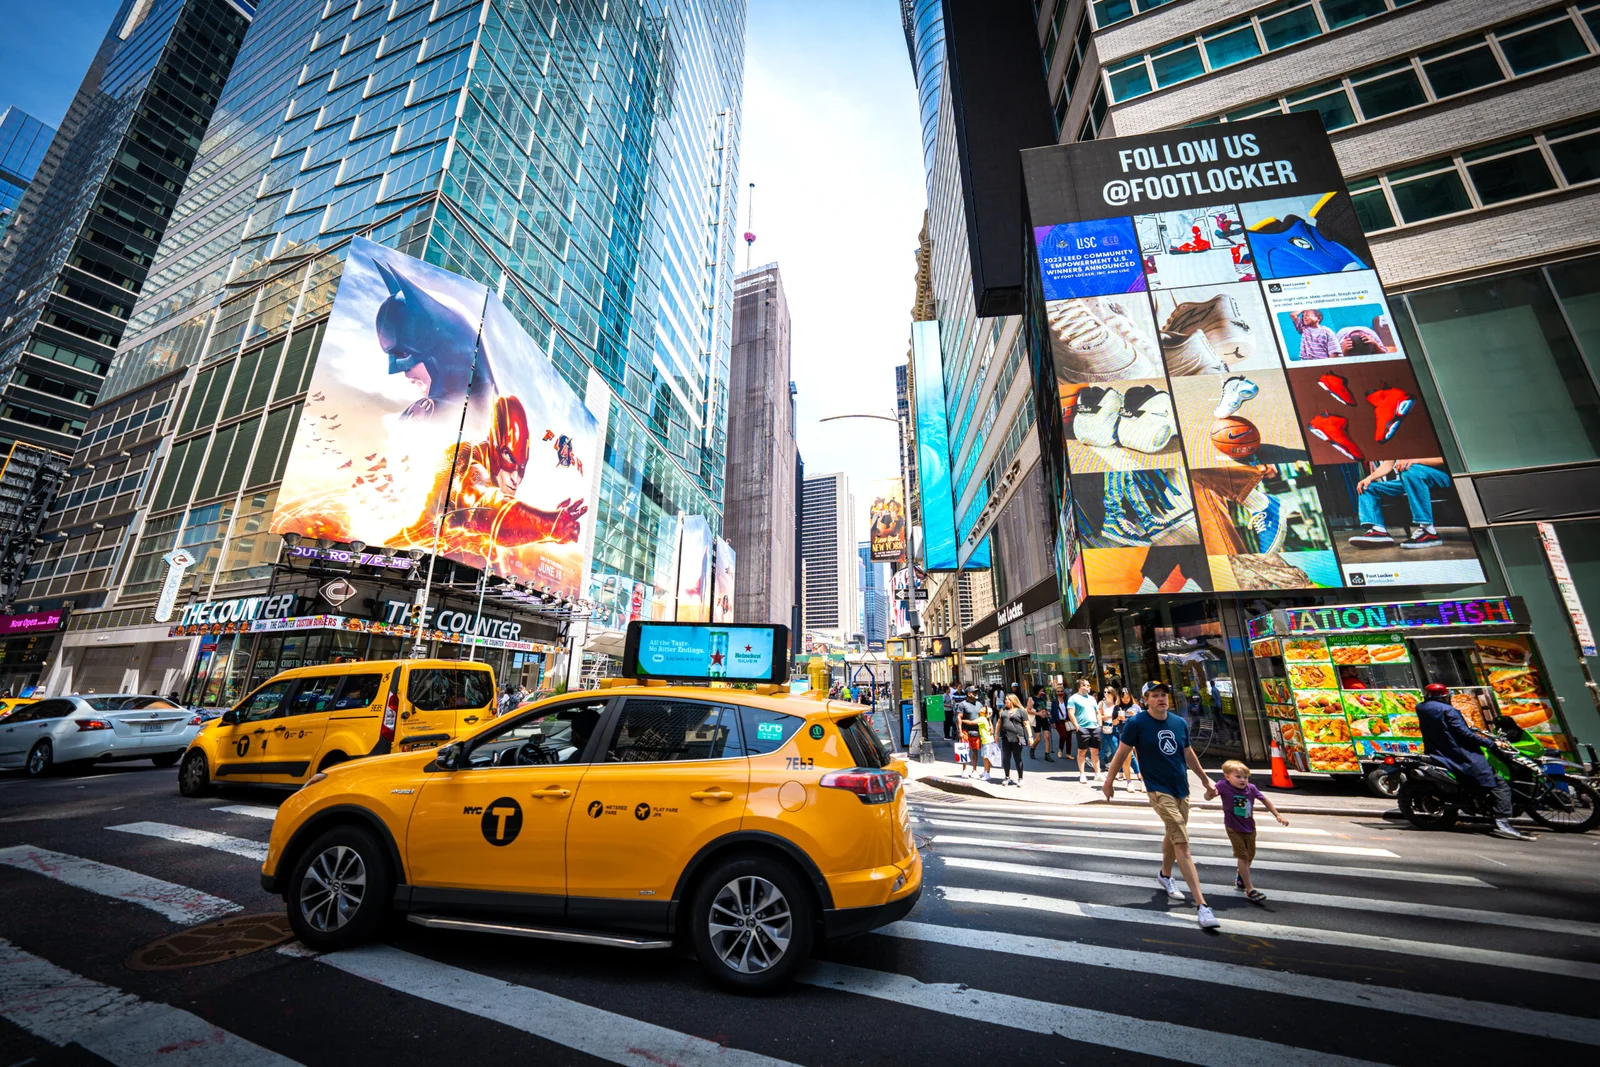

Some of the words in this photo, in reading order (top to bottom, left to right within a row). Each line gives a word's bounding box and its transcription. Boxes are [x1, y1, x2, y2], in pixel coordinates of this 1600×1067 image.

[1118, 138, 1219, 173] FOLLOW
[1222, 133, 1260, 159] US
[1102, 160, 1298, 206] @FOOTLOCKER
[1044, 256, 1062, 264] 2023
[1063, 254, 1082, 262] LEED
[1083, 249, 1134, 260] COMMUNITY
[1046, 267, 1083, 276] WINNERS
[1084, 261, 1136, 272] ANNOUNCED
[1050, 257, 1111, 269] EMPOWERMENT
[871, 542, 885, 552] NEW
[885, 541, 904, 551] YORK
[538, 562, 555, 577] JUNE
[180, 602, 211, 627] THE
[212, 594, 296, 624] COUNTER
[997, 608, 1008, 627] Foot
[1007, 602, 1024, 622] Locker
[10, 620, 23, 628] Now
[277, 619, 295, 629] COUNTER
[295, 618, 313, 628] CUSTOM
[313, 617, 337, 628] BURGERS
[387, 600, 435, 628] THE
[437, 610, 522, 640] COUNTER
[489, 639, 504, 648] COUNTER
[1328, 635, 1364, 643] MOSSAD
[678, 647, 705, 655] Endings.
[758, 723, 783, 733] curb
[786, 757, 814, 770] 7E63
[463, 806, 483, 815] NYC
